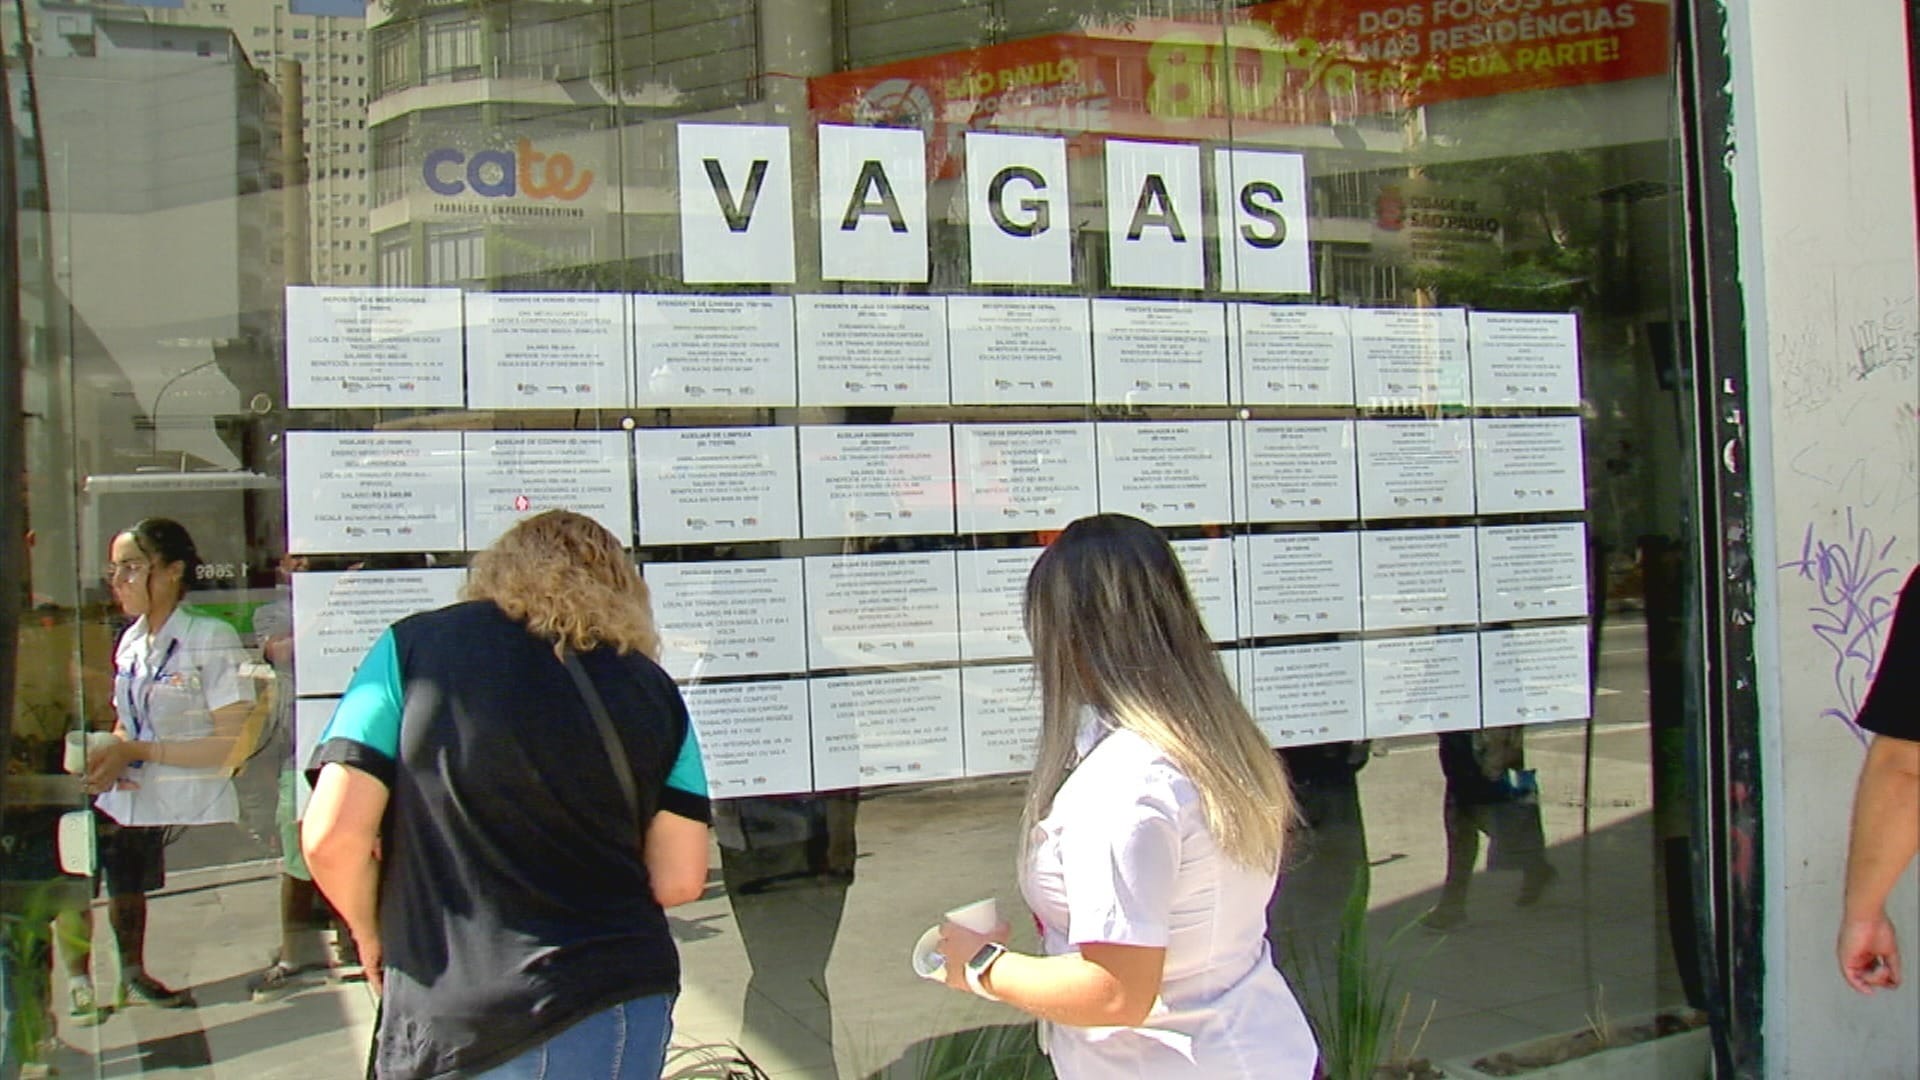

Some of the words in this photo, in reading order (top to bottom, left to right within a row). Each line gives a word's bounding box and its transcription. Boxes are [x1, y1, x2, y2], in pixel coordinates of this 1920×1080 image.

[1359, 6, 1423, 33] DOS
[1360, 35, 1420, 60] NAS
[1430, 3, 1636, 50] RESIDÊNCIAS
[999, 58, 1078, 90] PAULO
[1146, 20, 1355, 124] 80%
[1449, 47, 1510, 80] SUA
[1517, 37, 1620, 71] PARTE!
[423, 137, 595, 200] cate
[702, 158, 1287, 249] VAGAS
